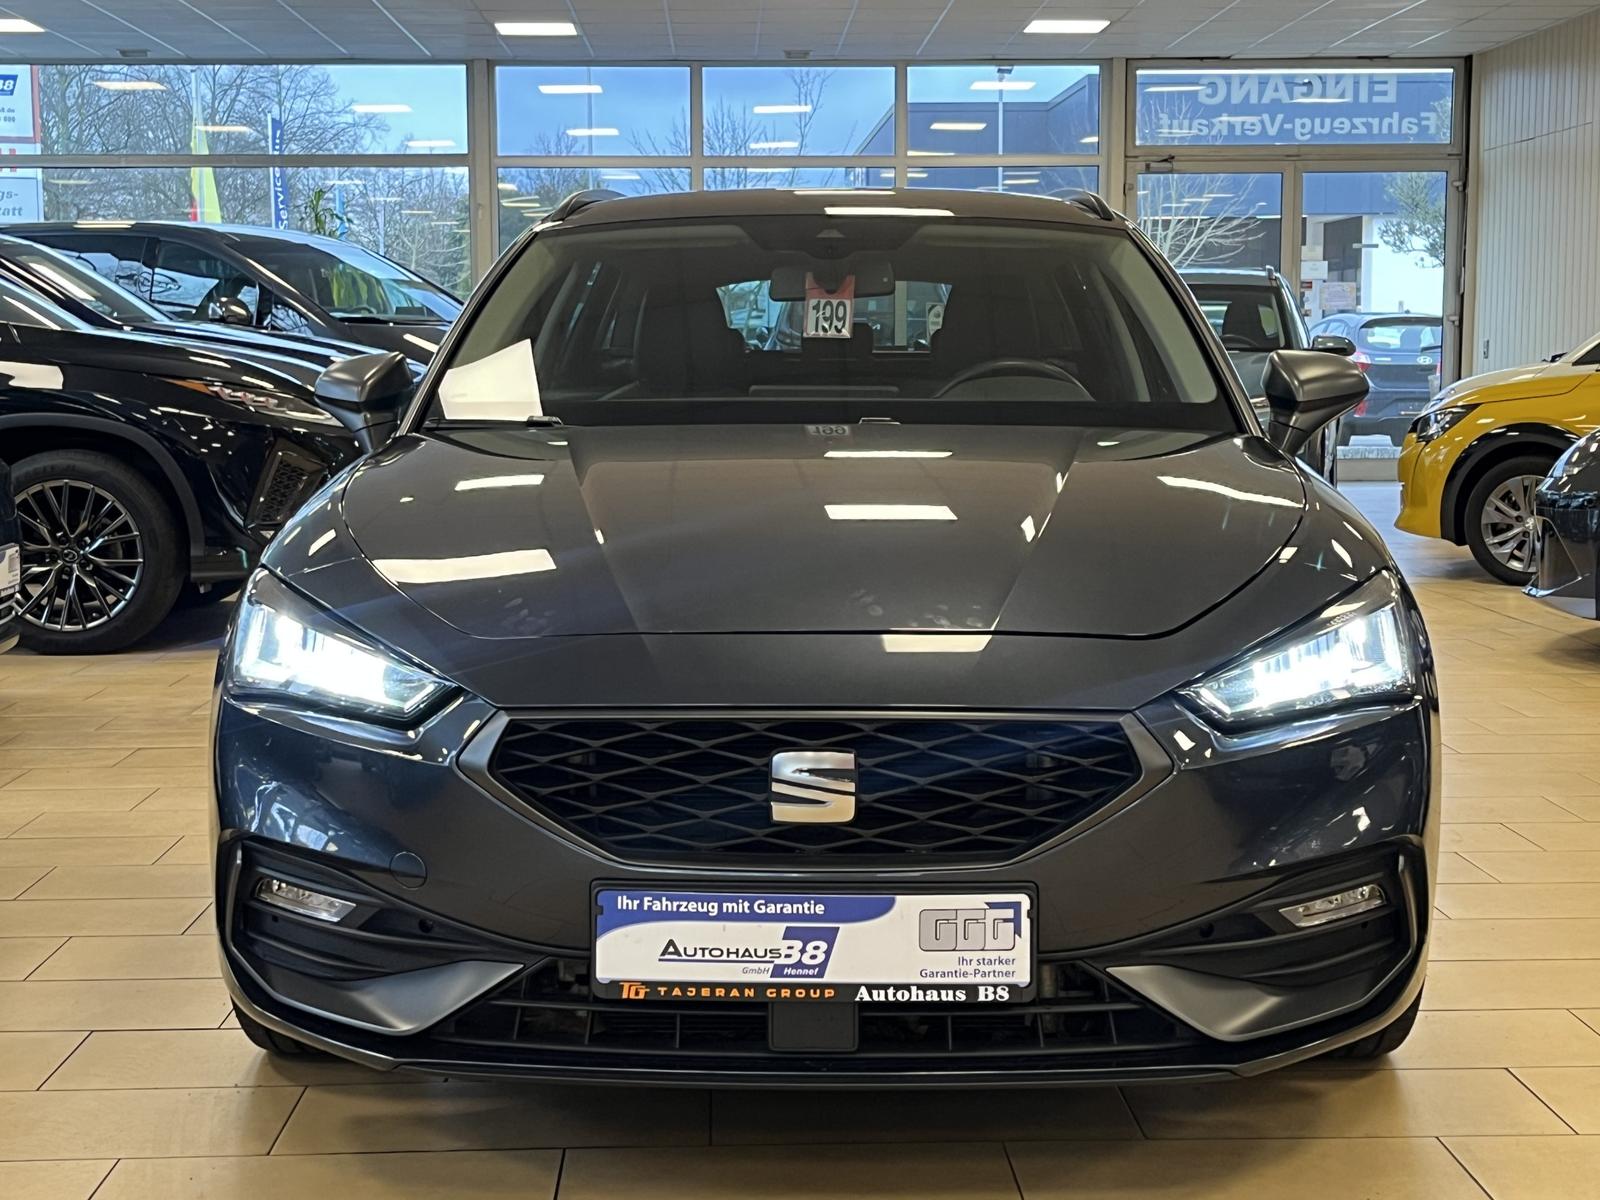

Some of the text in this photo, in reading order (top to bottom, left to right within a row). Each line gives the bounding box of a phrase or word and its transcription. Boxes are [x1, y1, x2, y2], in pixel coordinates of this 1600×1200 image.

[812, 300, 847, 333] 199
[617, 895, 825, 916] Ihr Fahrzeug mit Garantie
[918, 908, 1016, 952] GGG
[958, 956, 1016, 966] Ihr starker
[742, 966, 771, 976] GmbH
[783, 966, 819, 976] Hennef
[919, 968, 1016, 979] Garantie-Partner
[657, 986, 755, 998] TAJERAN
[766, 987, 836, 998] GROUP
[854, 985, 1010, 1002] Autohaus B8
